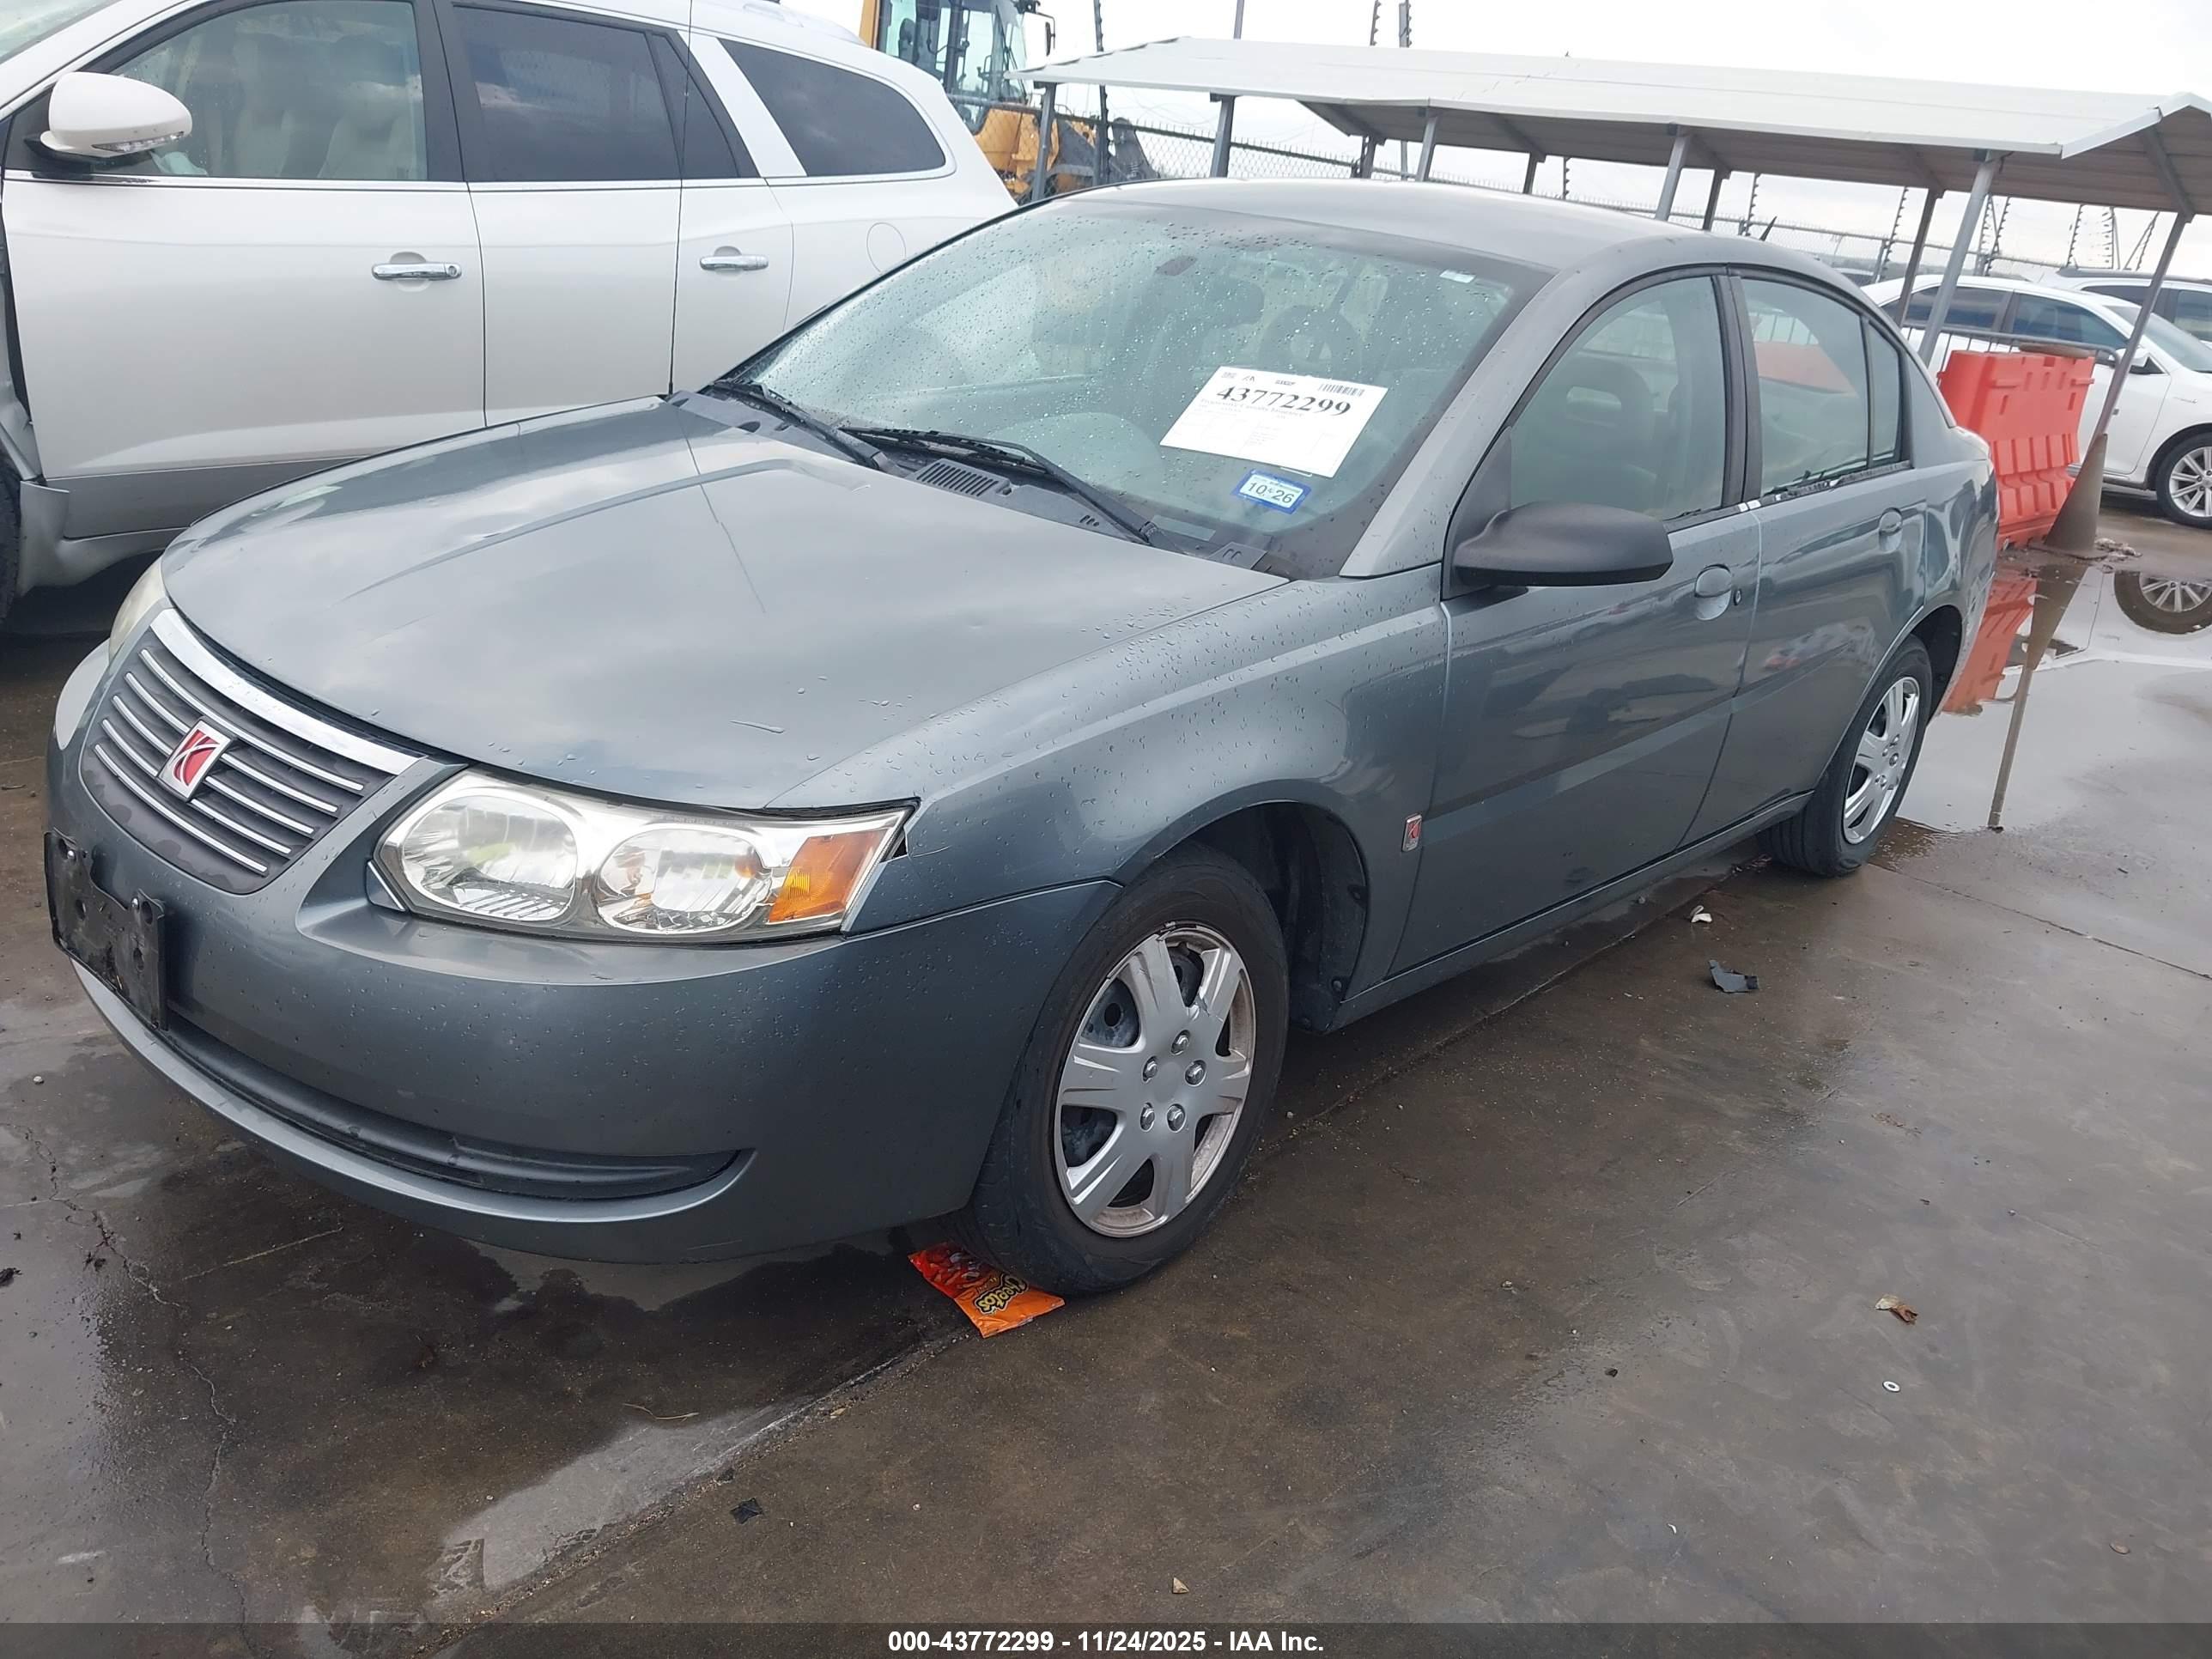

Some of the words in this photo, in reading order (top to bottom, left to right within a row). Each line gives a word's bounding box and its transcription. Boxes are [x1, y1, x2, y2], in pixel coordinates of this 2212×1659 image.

[1217, 386, 1352, 416] 43772299
[1248, 482, 1268, 495] 10
[1272, 489, 1295, 503] 26
[977, 1275, 1026, 1312] Cheetos
